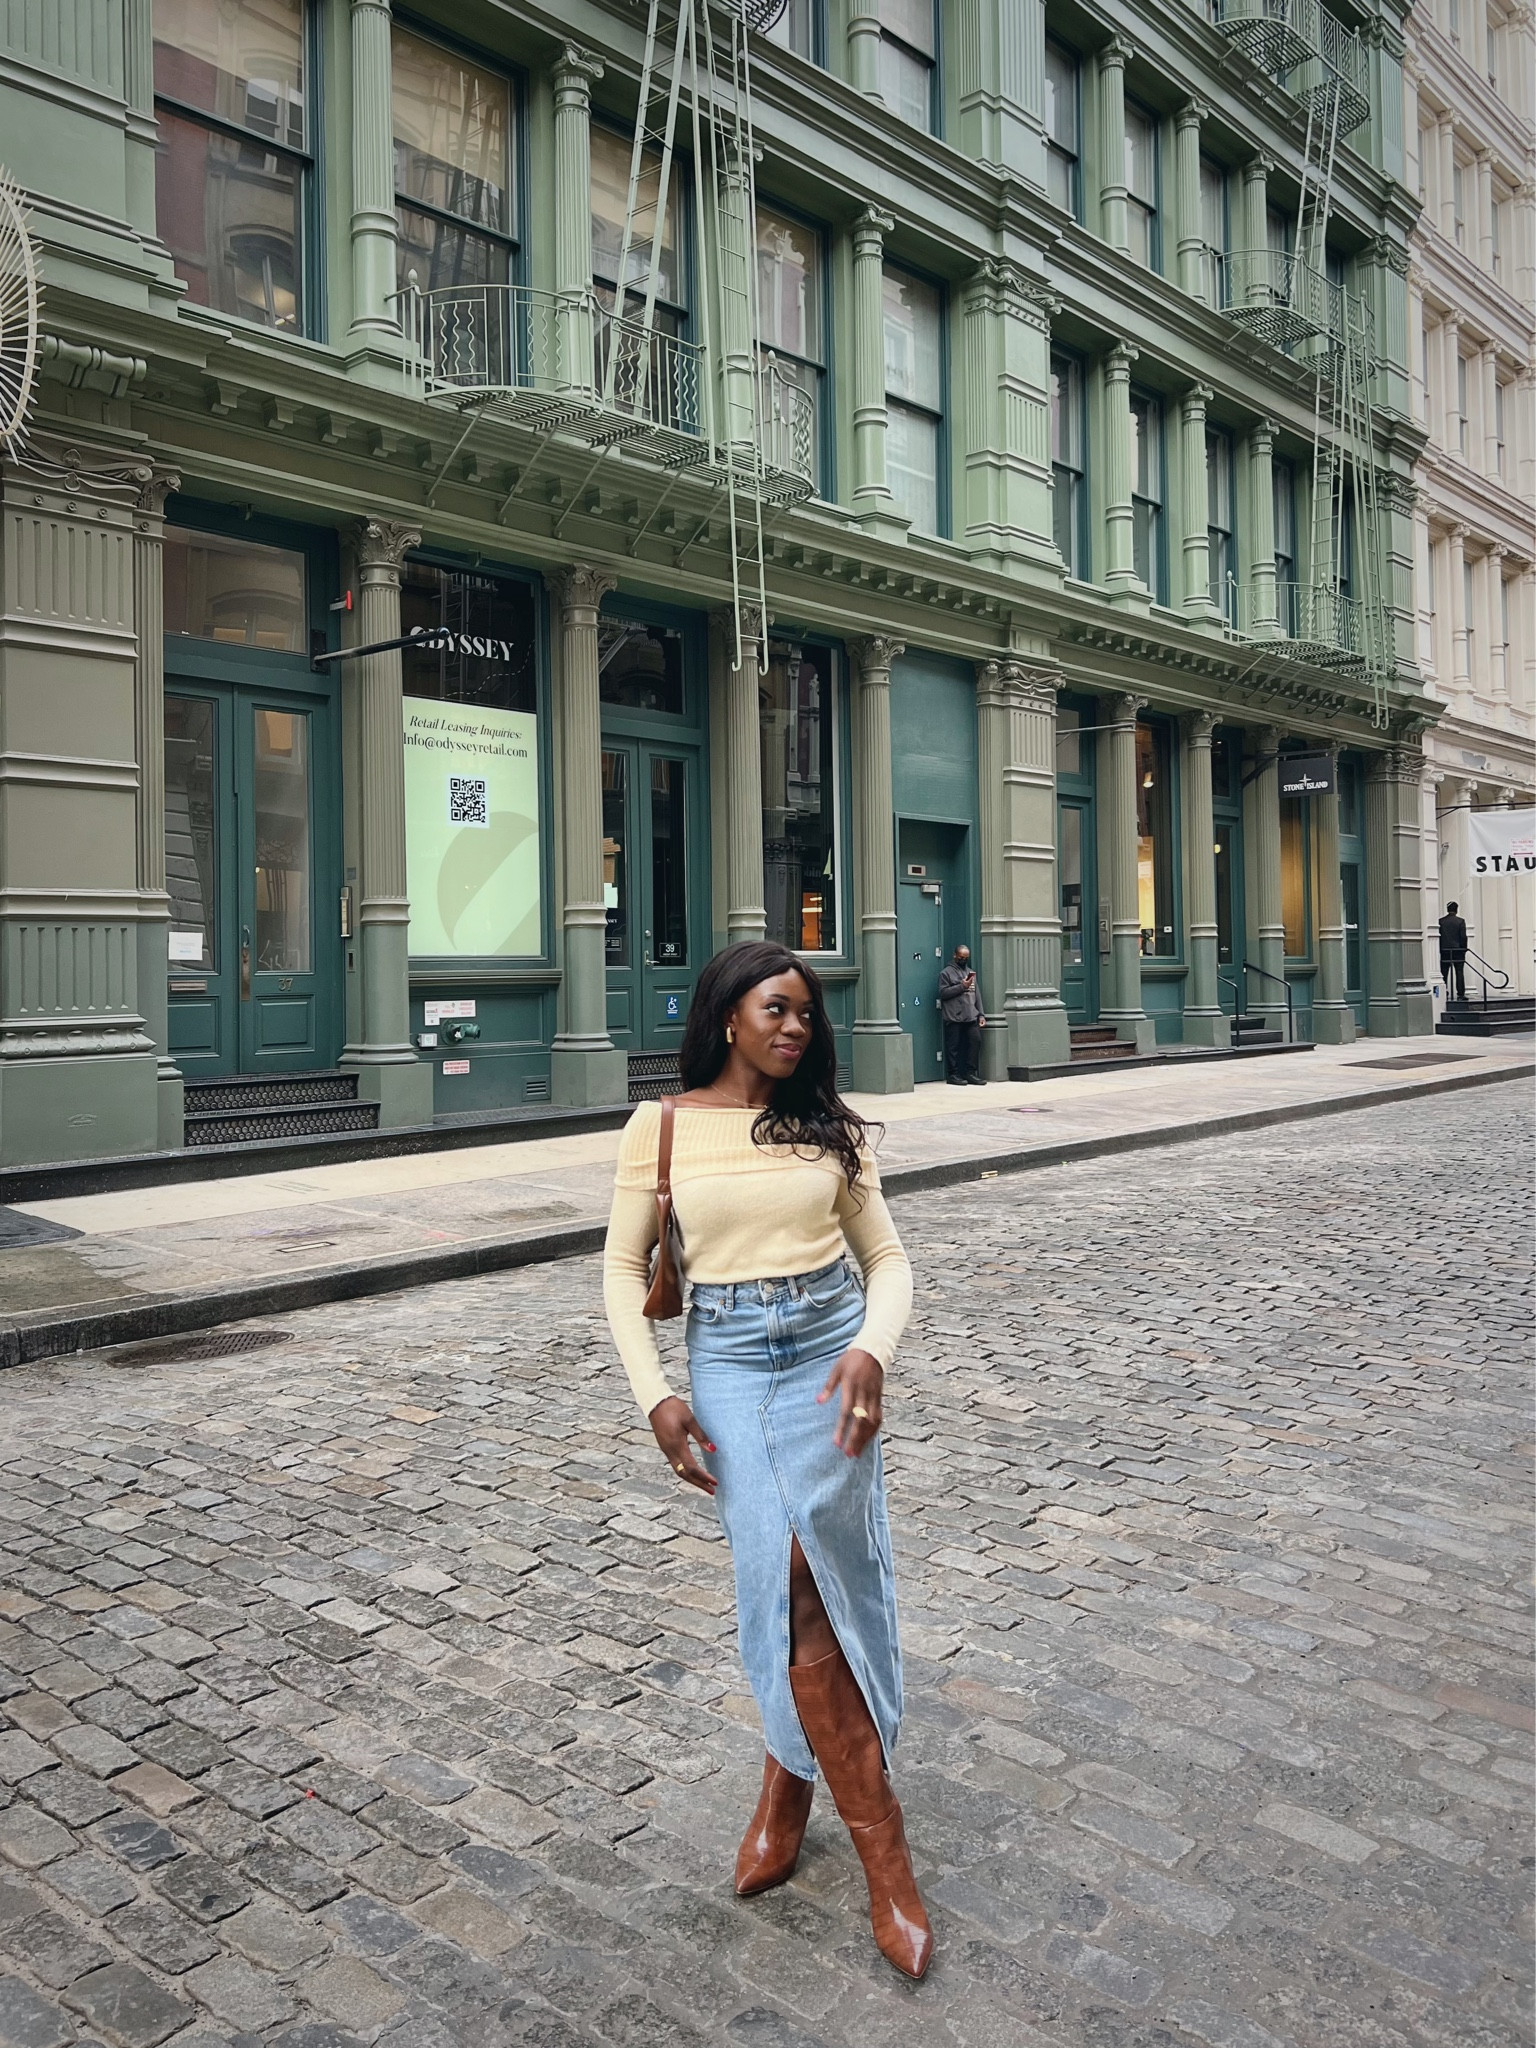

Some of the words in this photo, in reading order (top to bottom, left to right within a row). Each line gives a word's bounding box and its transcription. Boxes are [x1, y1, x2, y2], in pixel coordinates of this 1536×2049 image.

[409, 715, 440, 730] Retail
[440, 719, 479, 737] Leasing
[480, 724, 523, 740] Inquiries:
[403, 732, 528, 758] Info@odysseyretail.com
[1283, 783, 1305, 792] STONE
[1306, 780, 1329, 790] ISLAND
[665, 943, 675, 953] 39
[278, 977, 293, 992] 37
